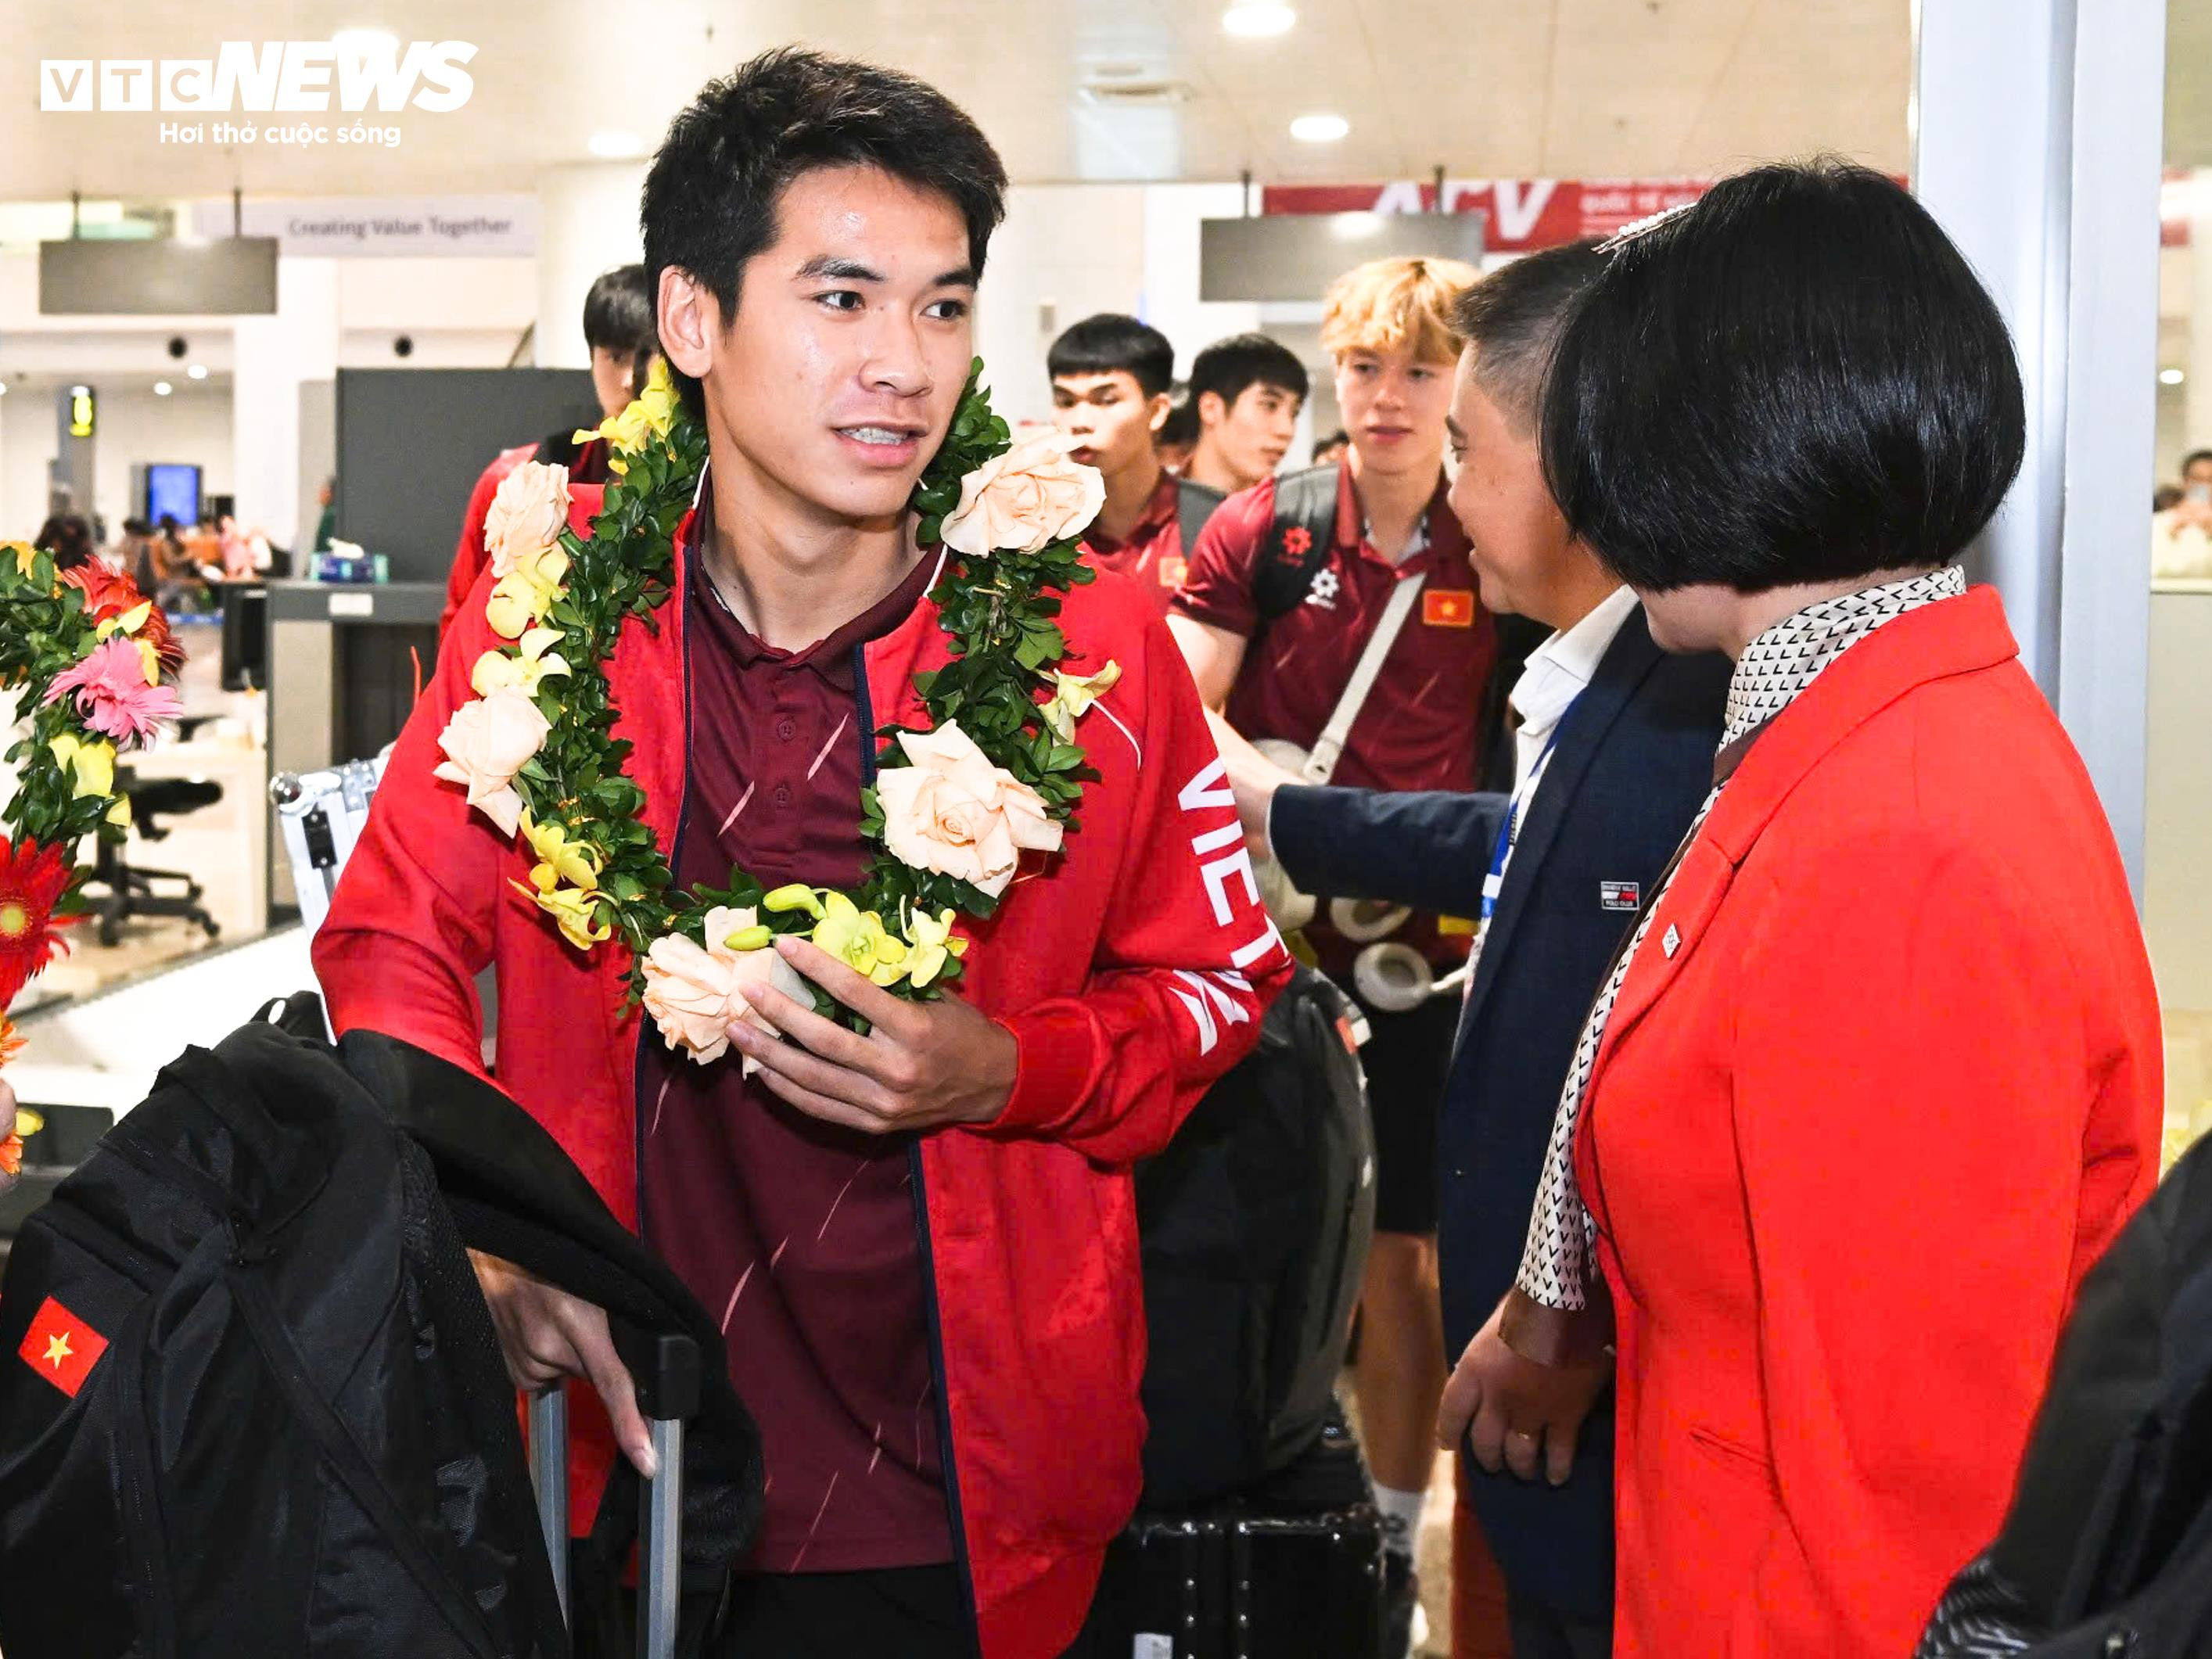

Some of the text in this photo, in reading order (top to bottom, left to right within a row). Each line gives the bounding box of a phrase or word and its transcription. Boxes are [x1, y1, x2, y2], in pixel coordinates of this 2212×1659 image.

[289, 215, 512, 239] Creating Value Together
